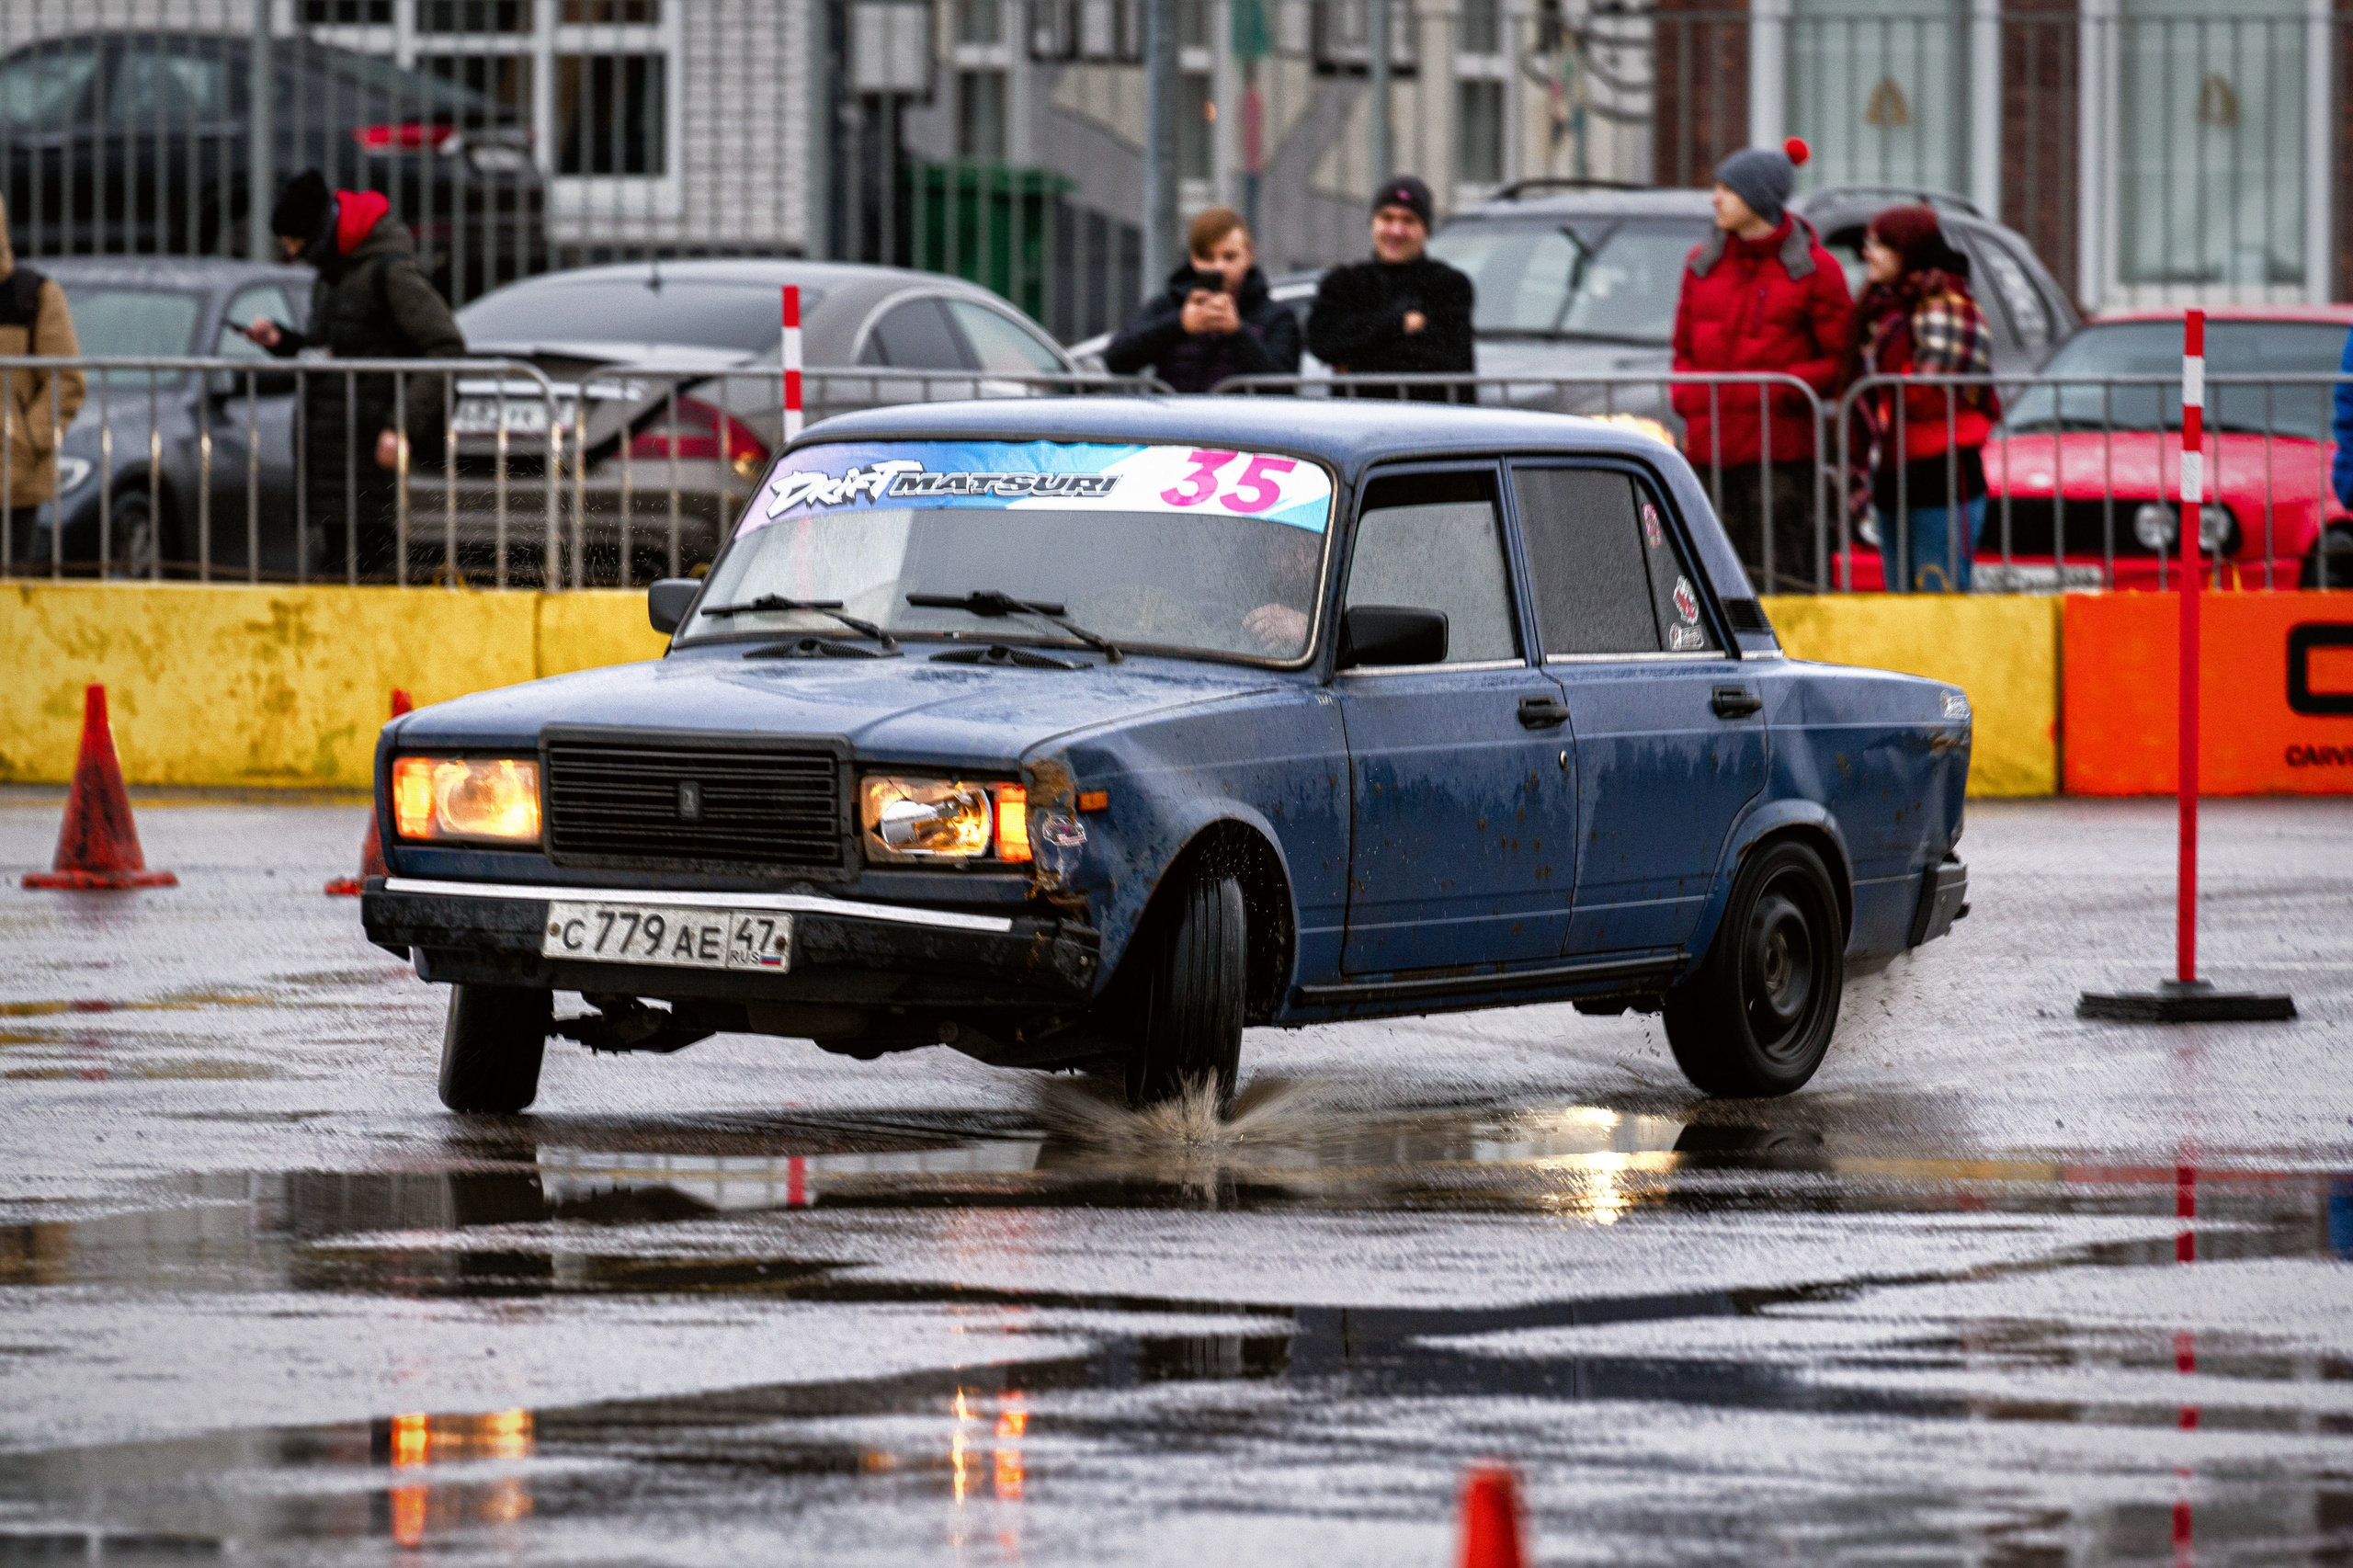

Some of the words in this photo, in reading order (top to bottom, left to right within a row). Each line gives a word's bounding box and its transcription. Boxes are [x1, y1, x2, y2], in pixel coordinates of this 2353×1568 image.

[887, 472, 1123, 497] MATSURI
[1160, 449, 1299, 513] 35
[730, 950, 760, 965] RUS
